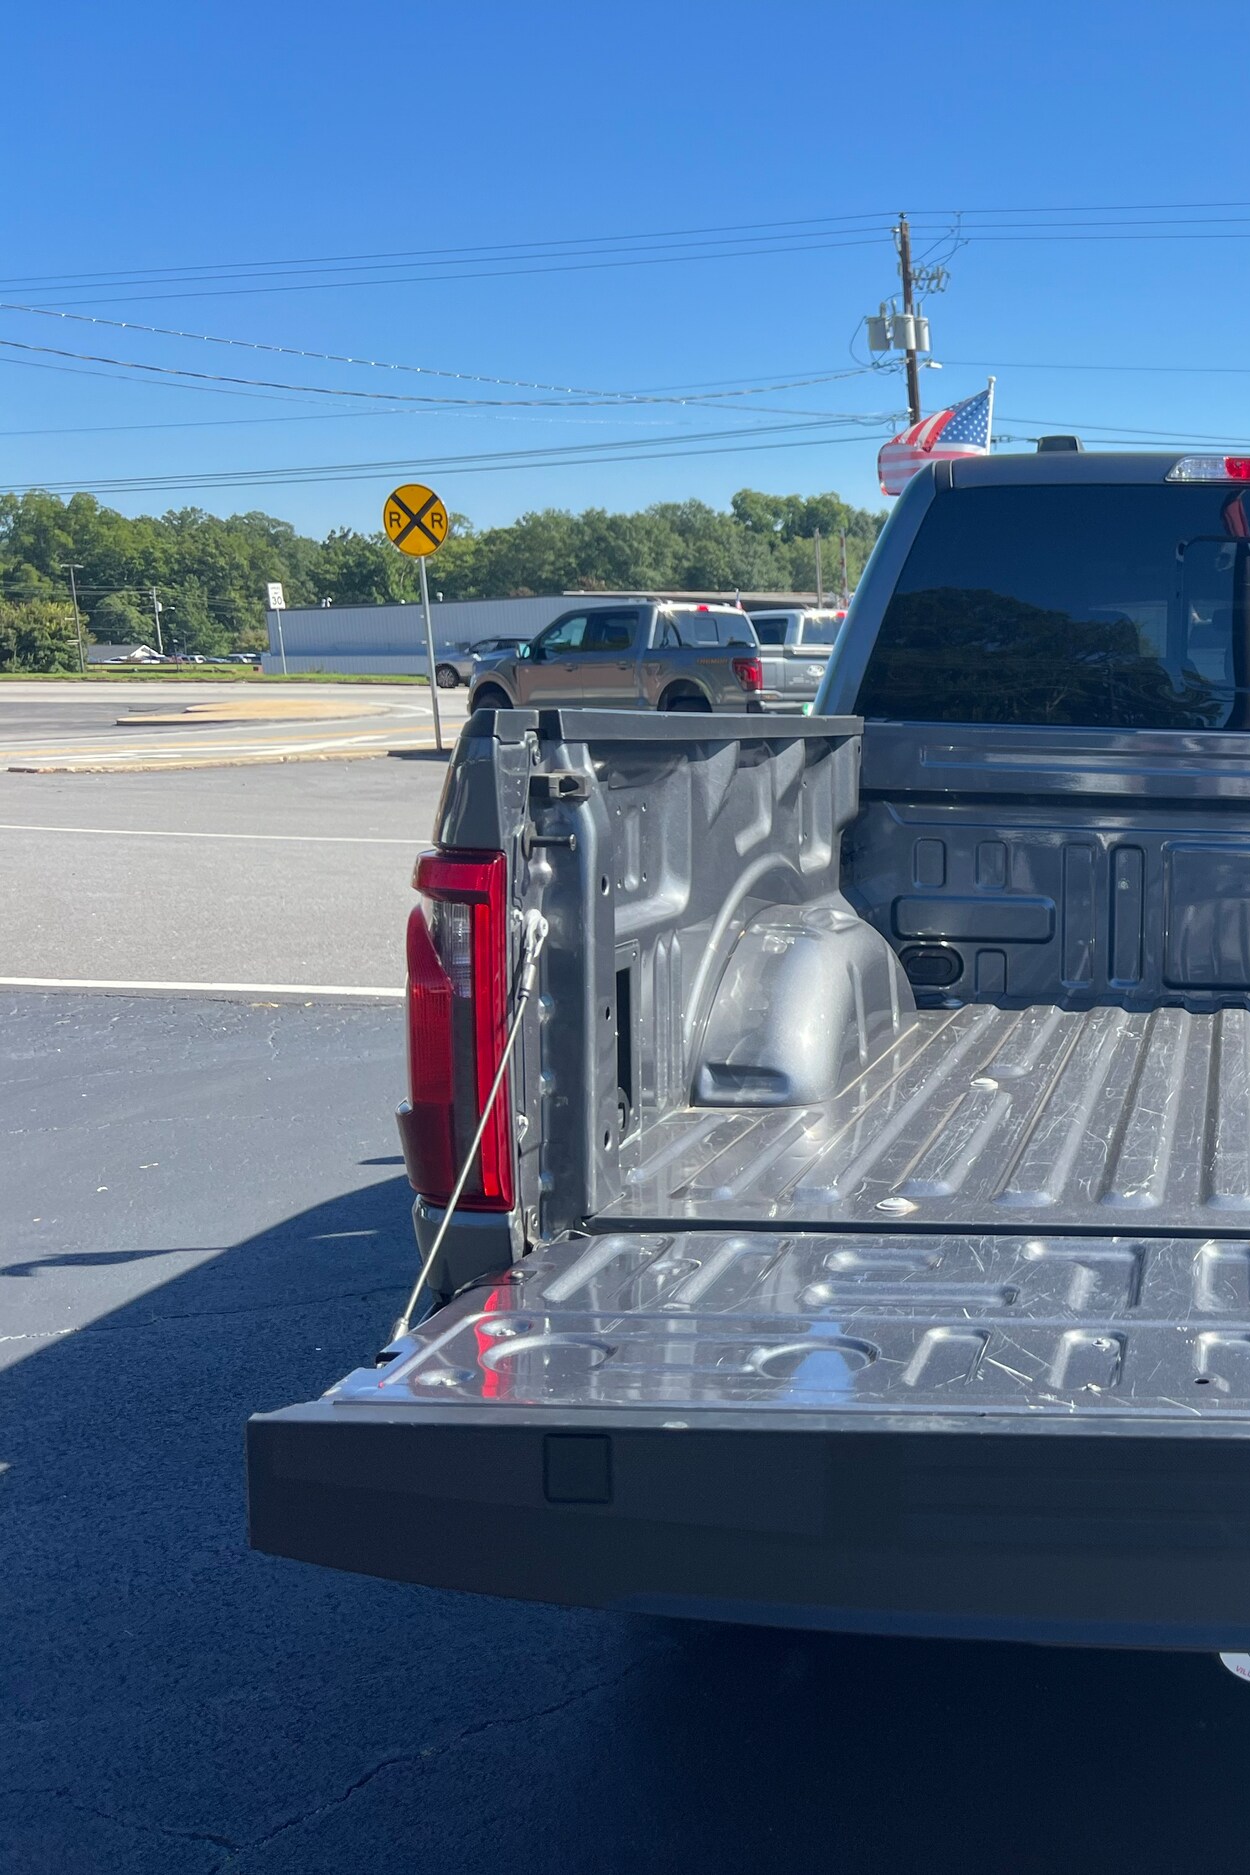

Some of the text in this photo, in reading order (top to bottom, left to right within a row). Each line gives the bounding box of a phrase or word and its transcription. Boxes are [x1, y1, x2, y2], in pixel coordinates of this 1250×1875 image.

[389, 511, 444, 529] R R
[272, 596, 282, 605] 30
